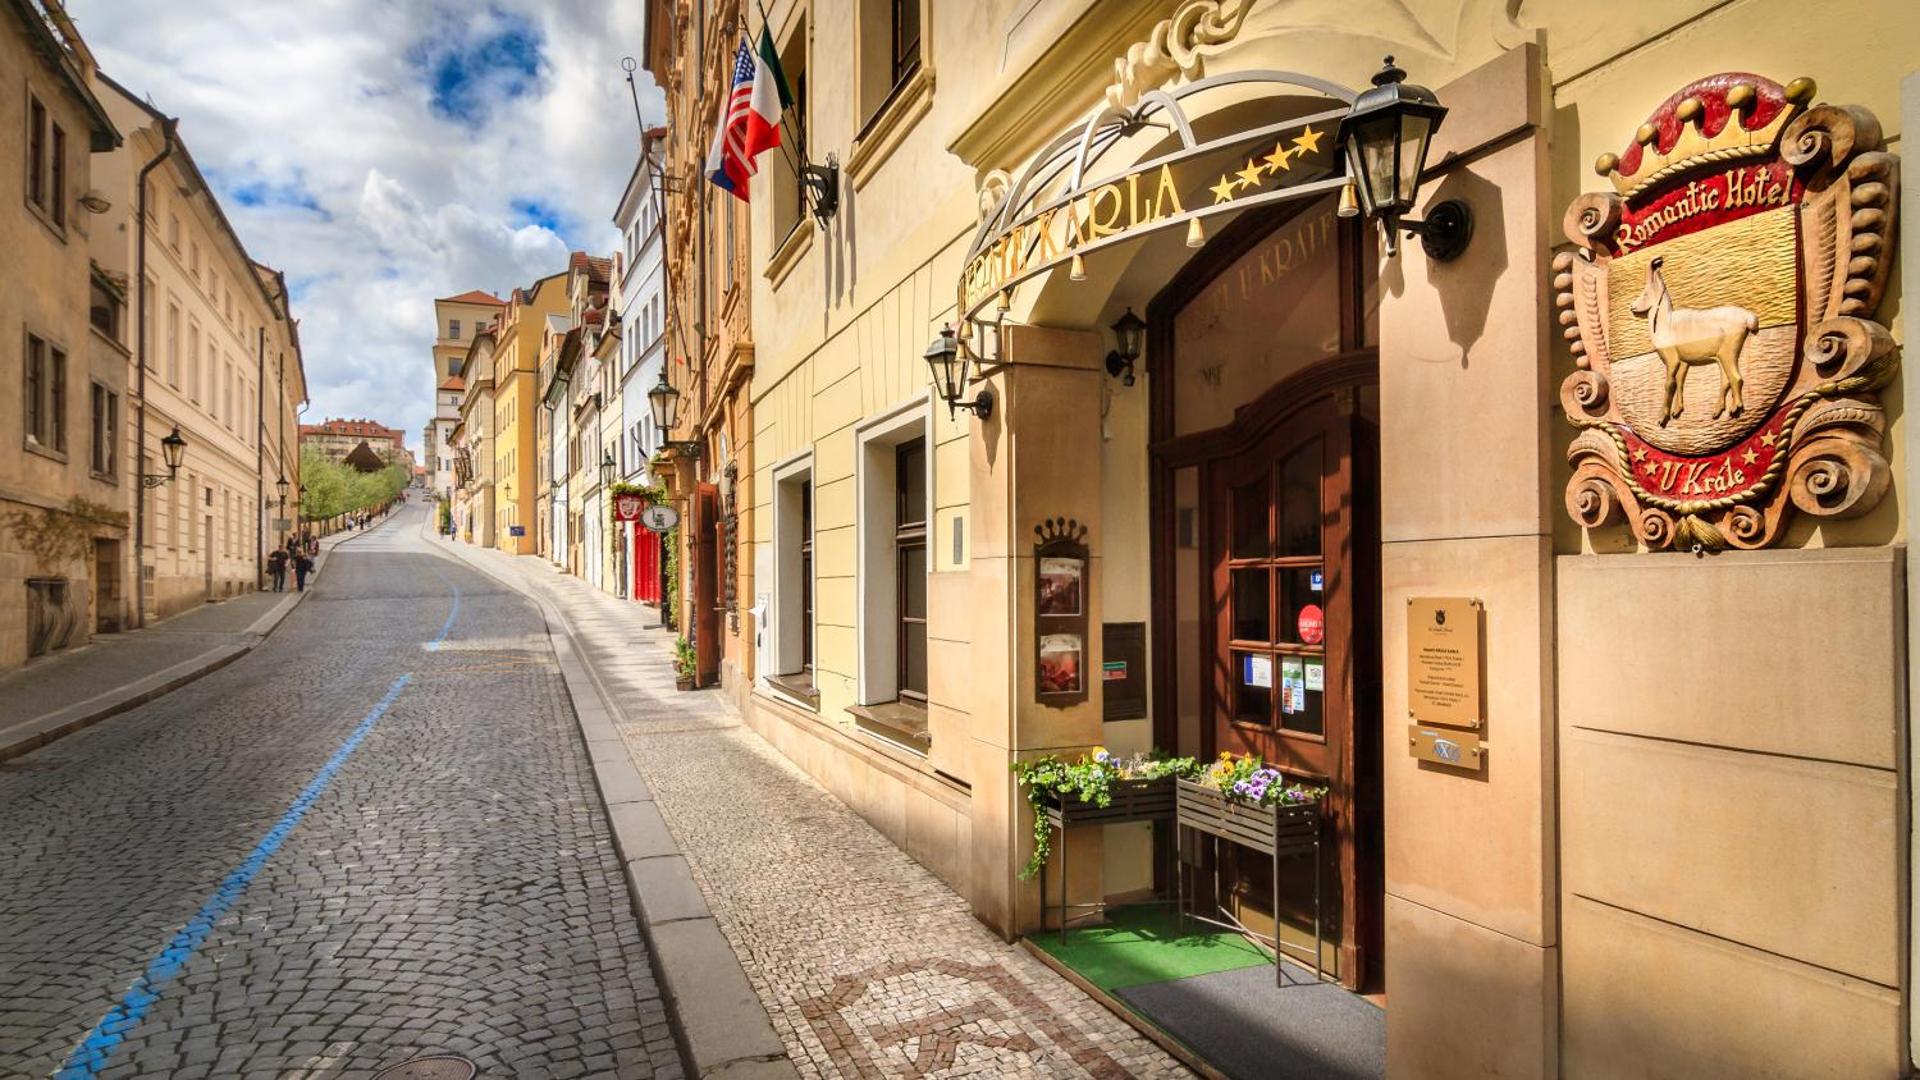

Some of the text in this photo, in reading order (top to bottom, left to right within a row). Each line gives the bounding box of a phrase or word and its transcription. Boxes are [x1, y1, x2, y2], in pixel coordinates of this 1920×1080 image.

[1038, 163, 1187, 262] KARLA
[1616, 166, 1795, 256] Romantic Hotel
[1661, 461, 1684, 491] U
